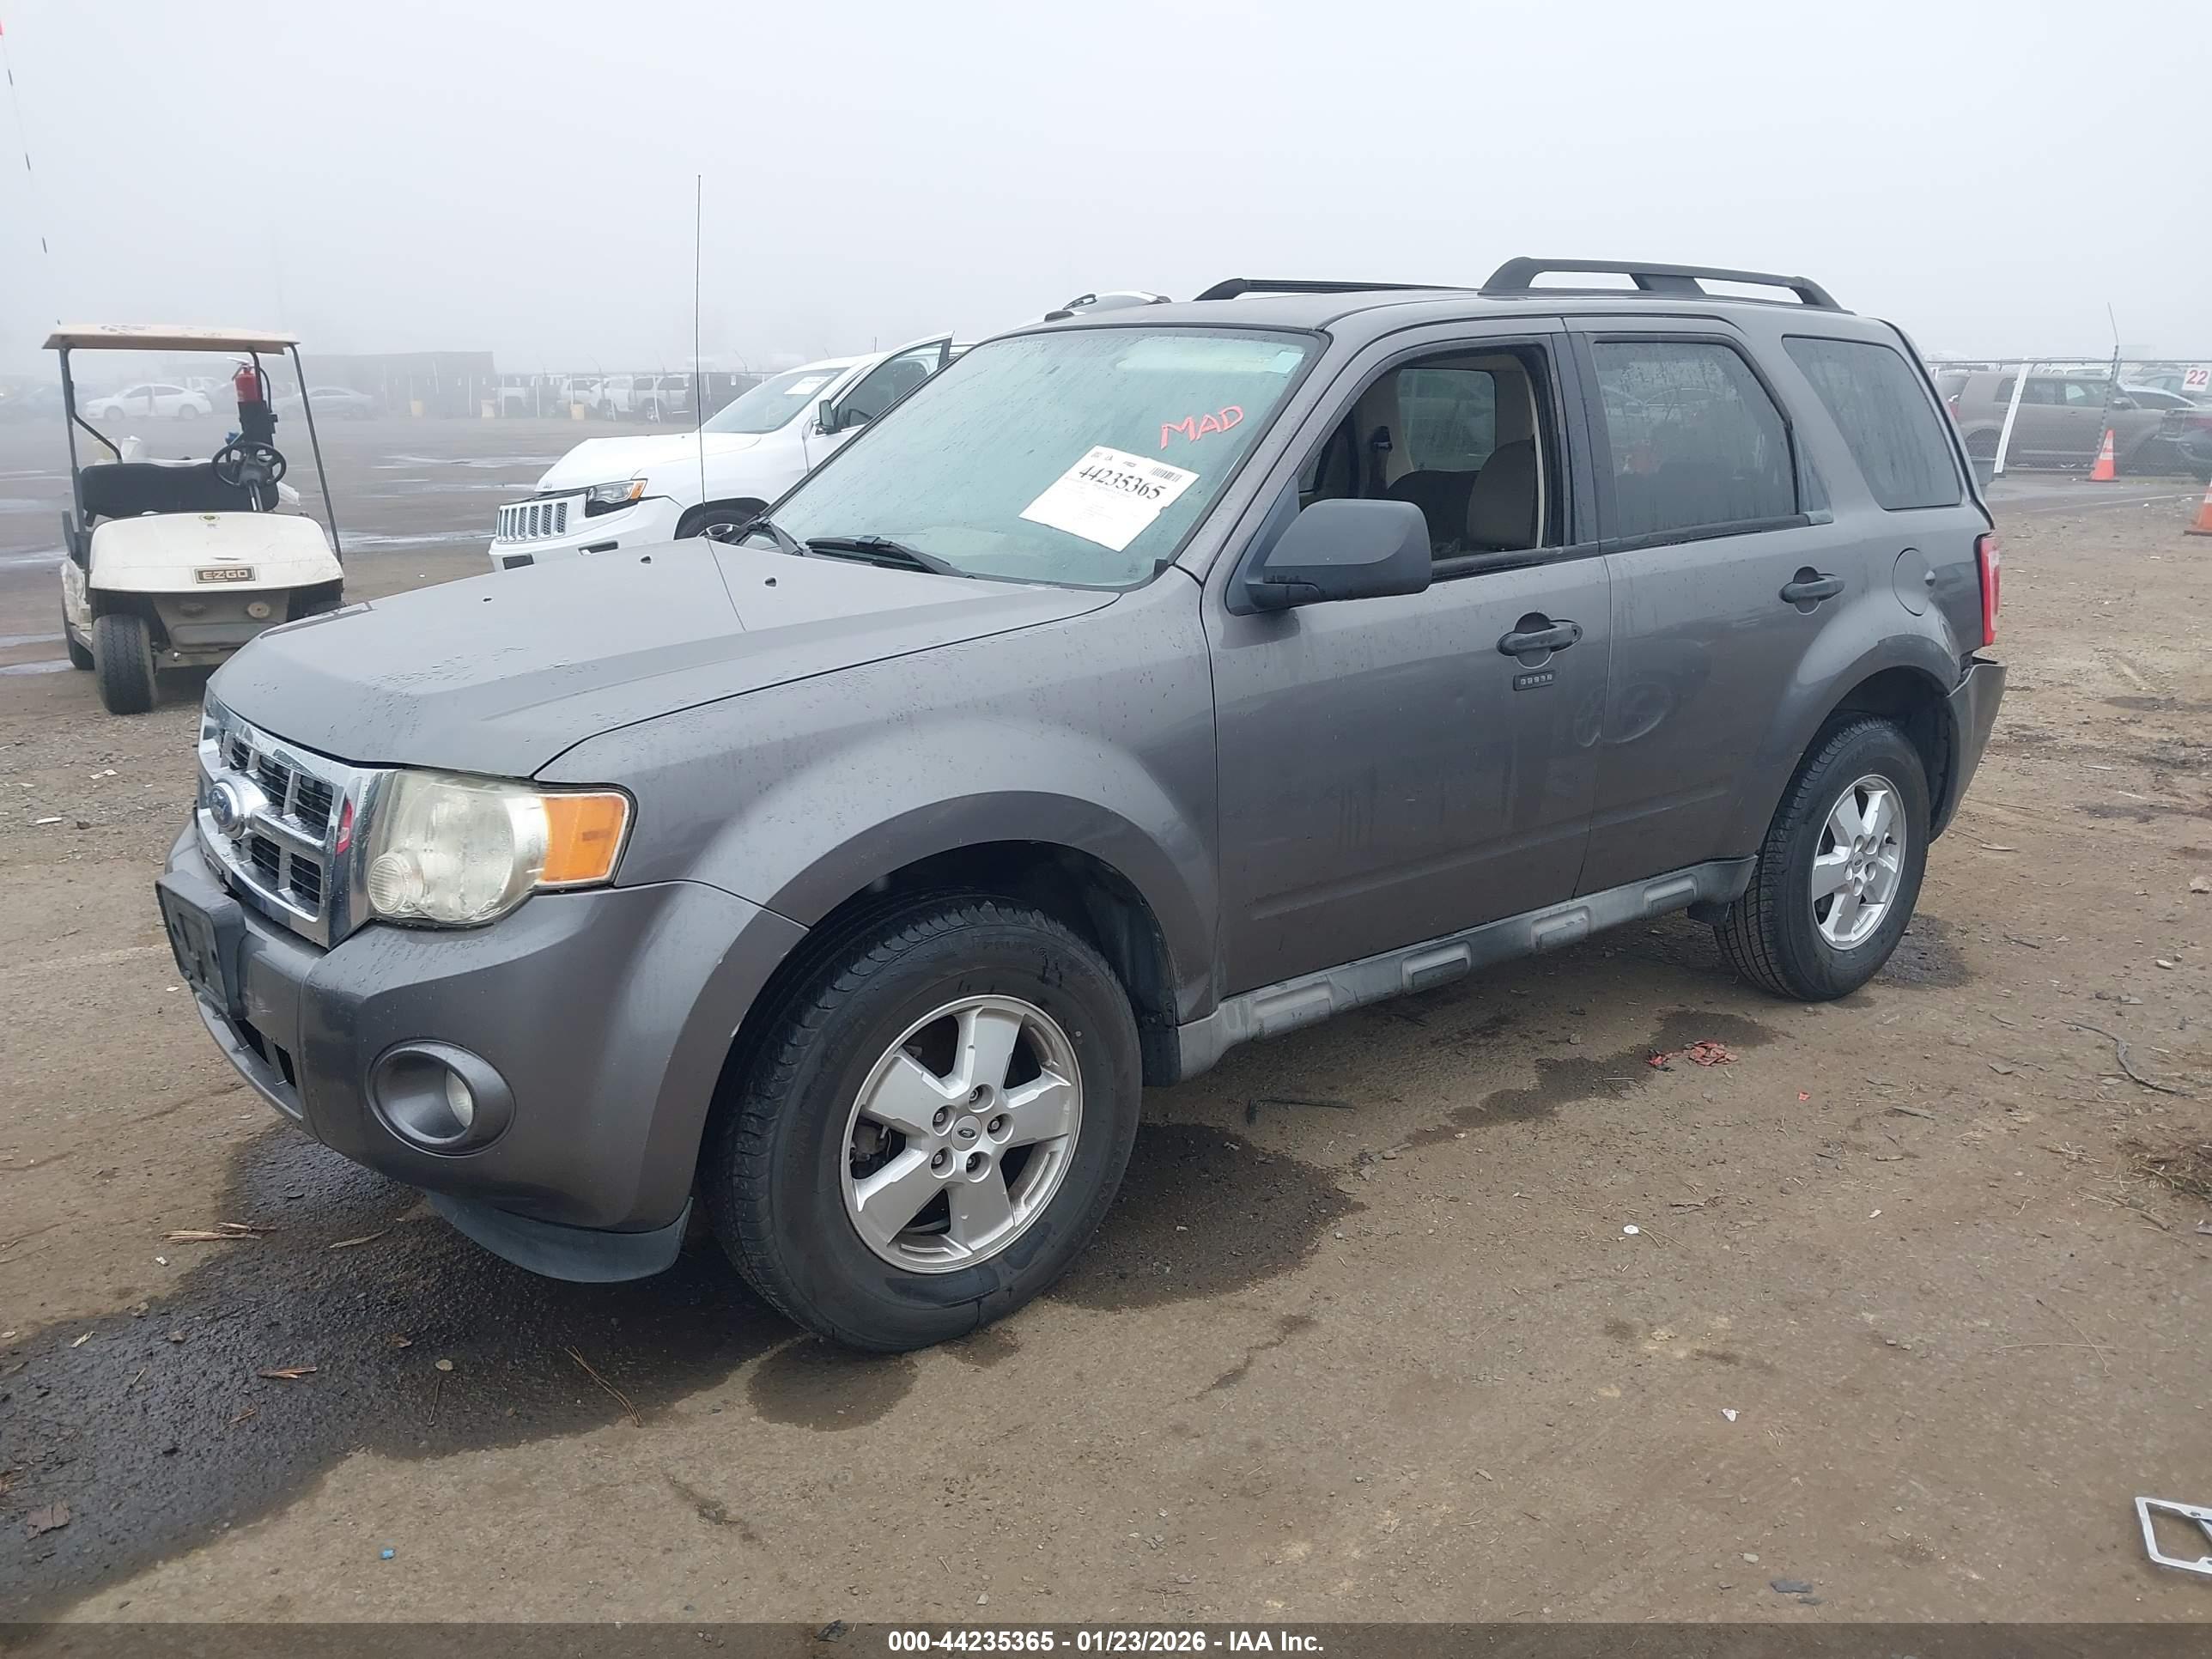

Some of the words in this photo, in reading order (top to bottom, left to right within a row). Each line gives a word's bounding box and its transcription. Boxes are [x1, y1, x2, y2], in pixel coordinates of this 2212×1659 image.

[2186, 370, 2209, 385] 22
[1160, 405, 1244, 451] MAD
[1079, 465, 1167, 500] 44235365
